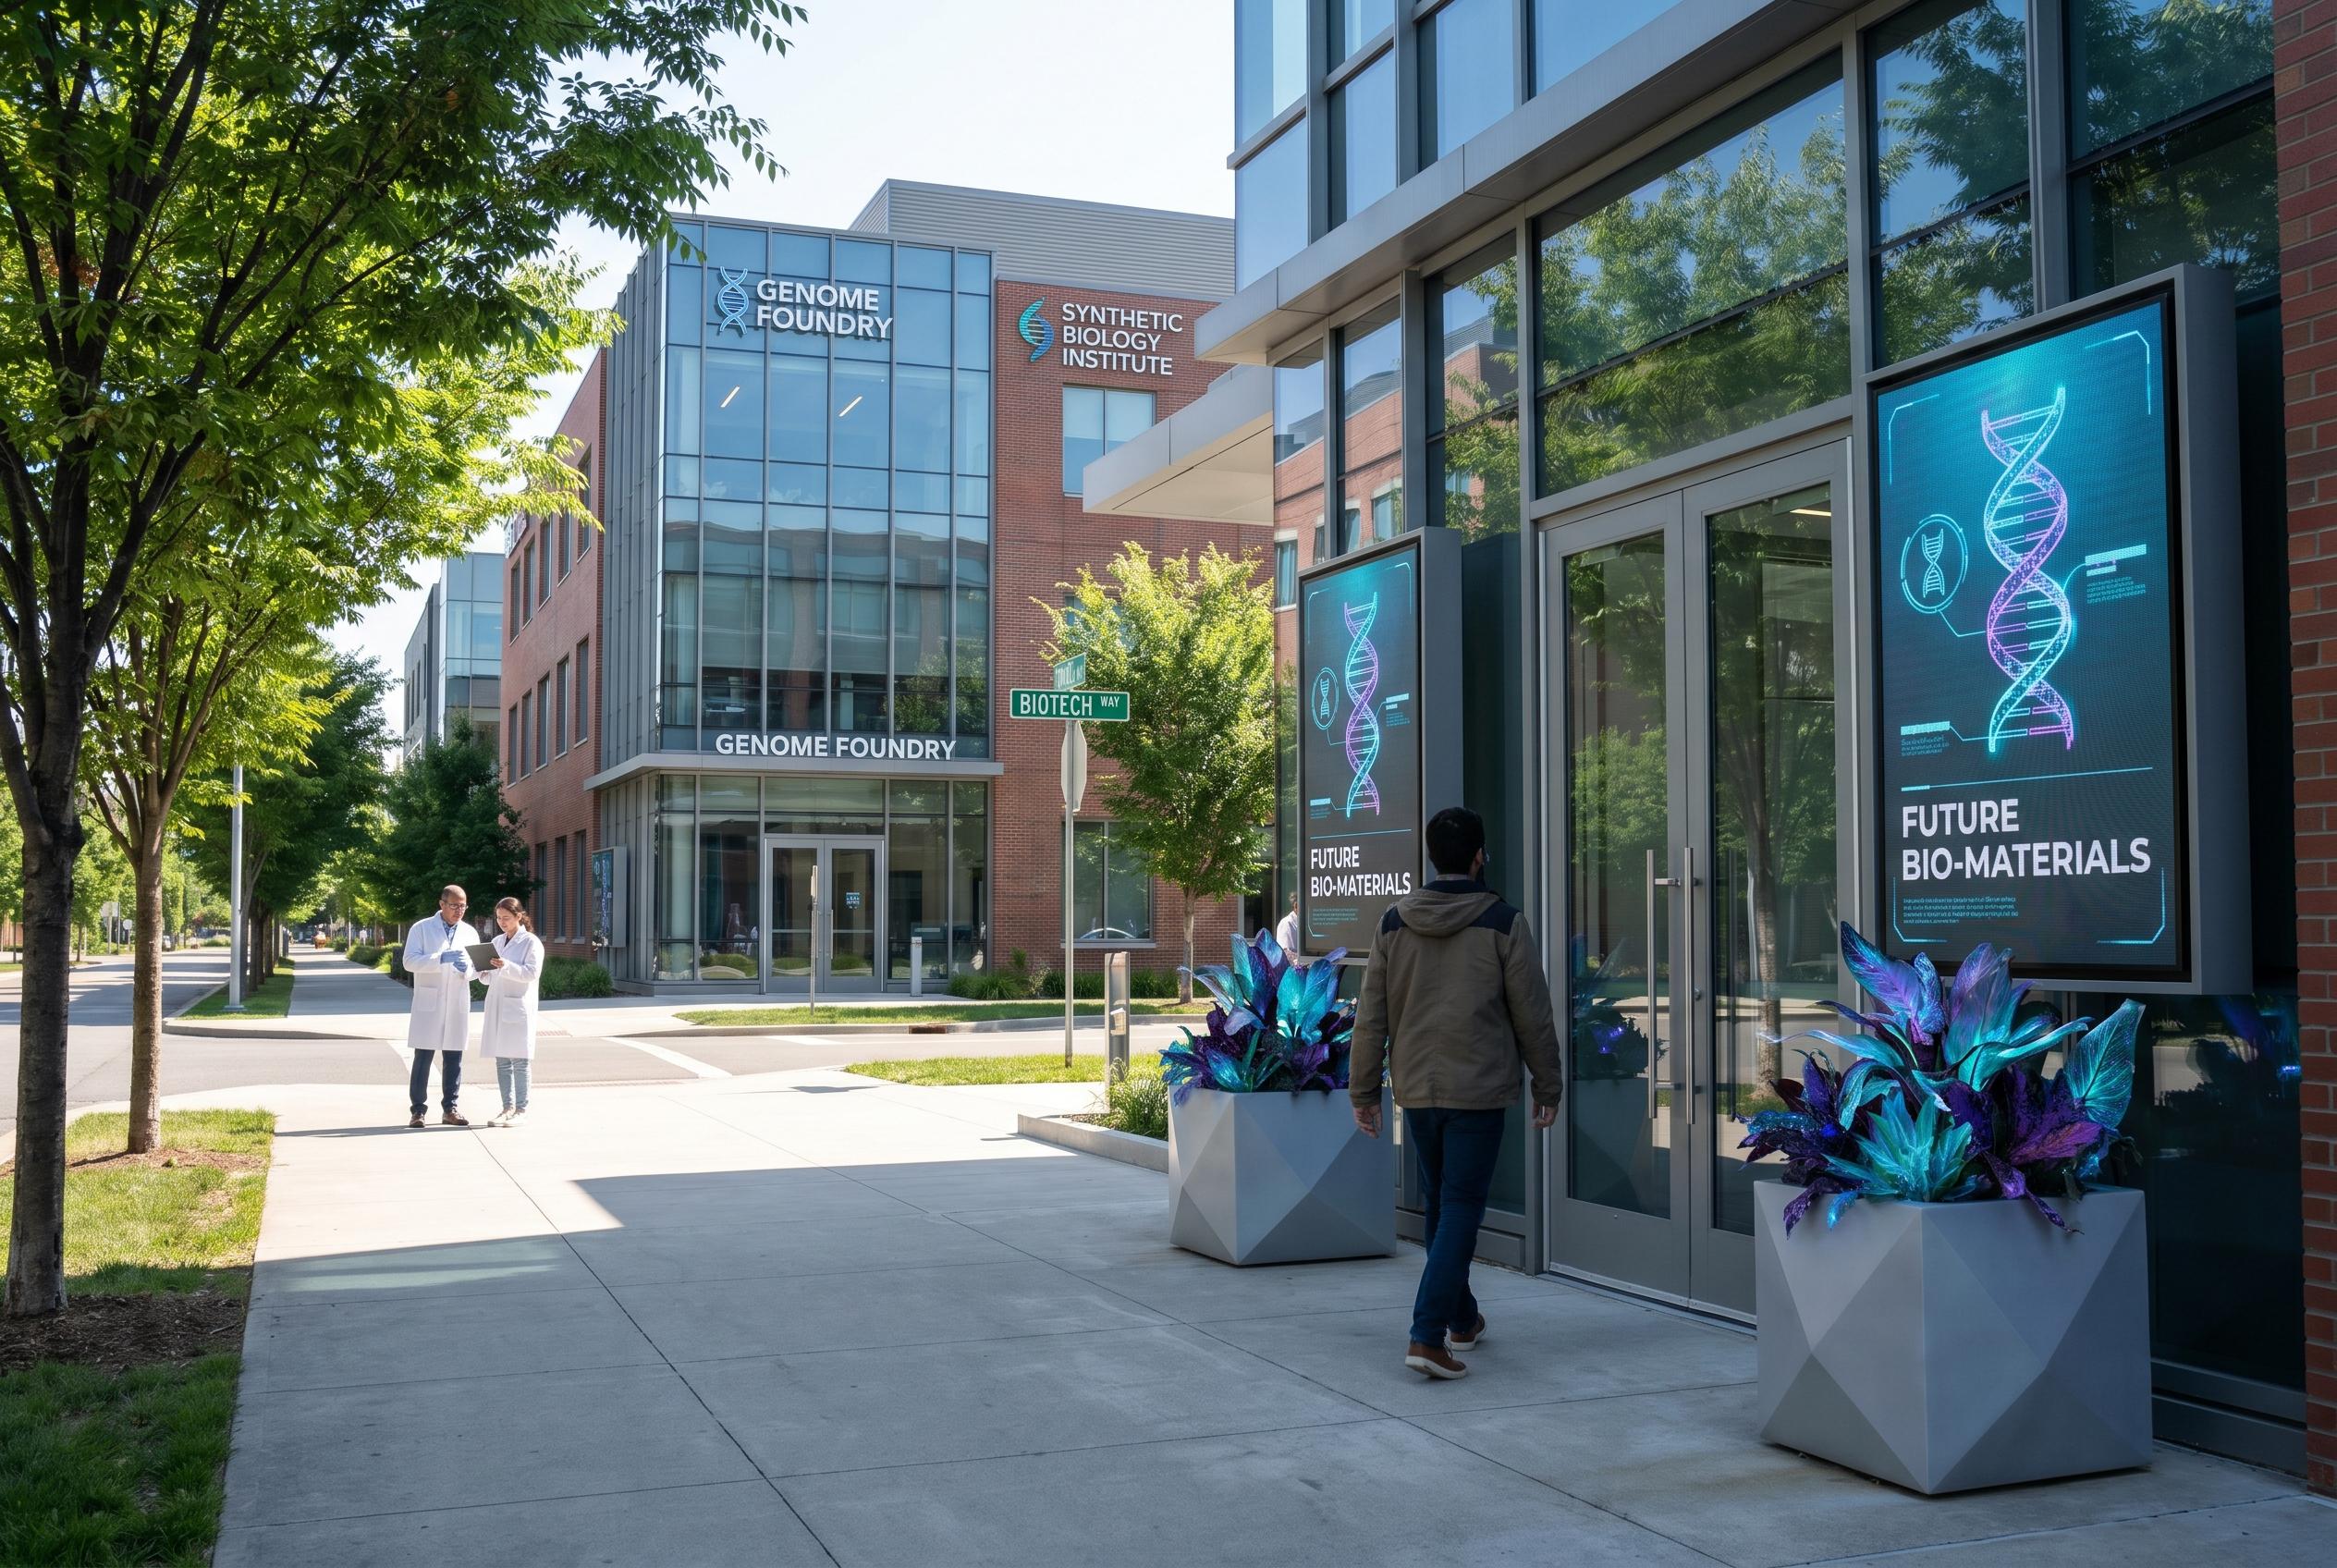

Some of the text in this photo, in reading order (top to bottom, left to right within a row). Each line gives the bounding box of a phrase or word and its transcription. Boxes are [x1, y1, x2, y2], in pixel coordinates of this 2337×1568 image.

[756, 279, 879, 311] GENOME
[757, 305, 893, 338] FOUNDRY
[1062, 303, 1183, 332] SYNTHETIC
[1063, 325, 1162, 352] BIOLOGY
[1063, 349, 1173, 375] INSTITUTE
[1020, 693, 1120, 717] BIOTECH WAY
[716, 733, 957, 761] GENOME FOUNDRY
[1903, 798, 2020, 838] FUTURE
[1310, 846, 1360, 869] FUTURE
[1903, 837, 2151, 881] BIO-MATERIALS
[1310, 872, 1412, 897] BIO-MATERIALS
